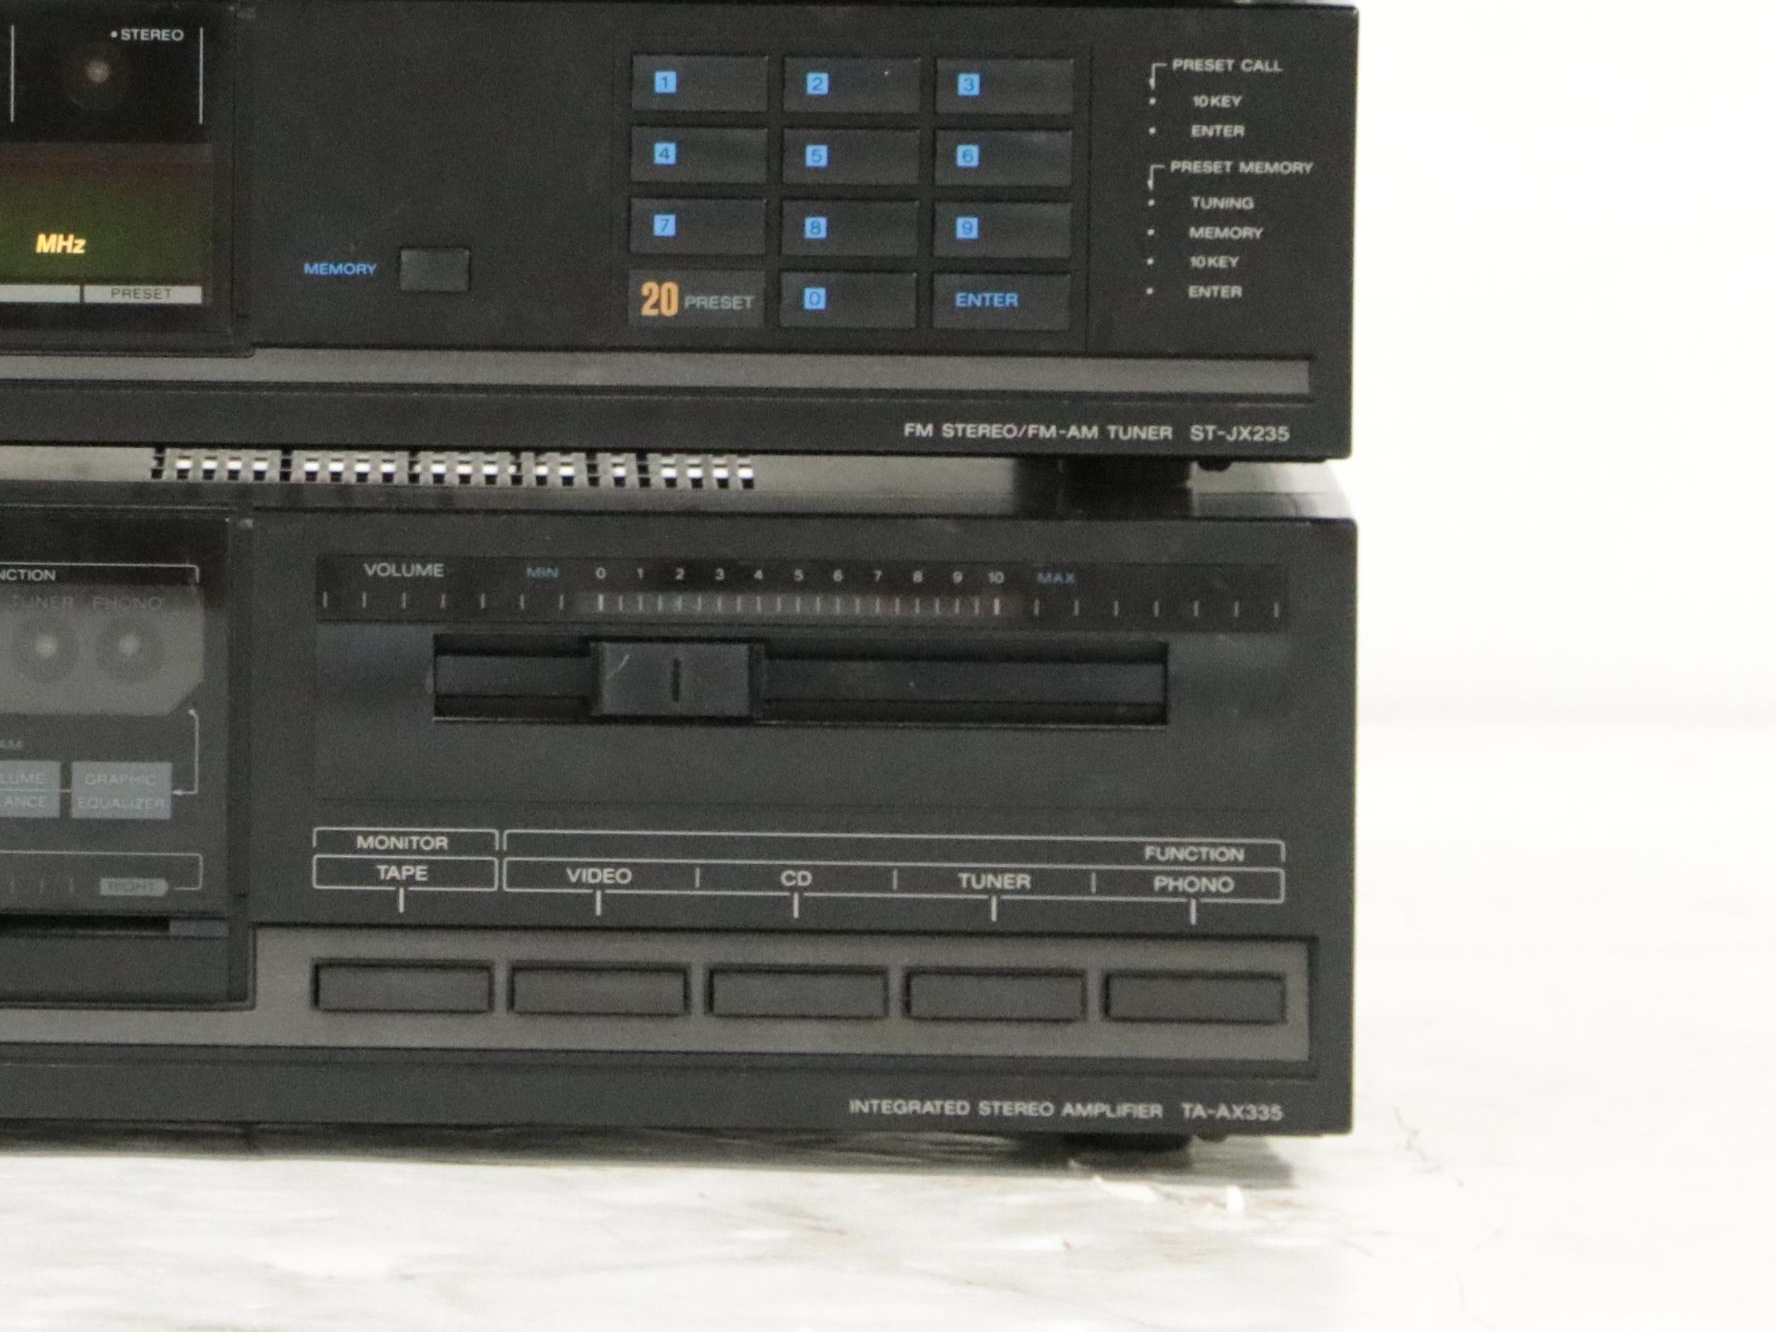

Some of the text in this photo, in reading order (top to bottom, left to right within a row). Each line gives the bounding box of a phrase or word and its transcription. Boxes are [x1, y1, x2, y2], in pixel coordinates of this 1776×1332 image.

[121, 28, 184, 41] STEREO
[1172, 59, 1283, 72] PRESET CALL
[1191, 125, 1244, 137] ENTER
[1171, 161, 1313, 174] PRESET MEMORY
[1191, 197, 1254, 209] TUNING
[1189, 226, 1262, 239] MEMORY
[36, 234, 86, 254] MHz
[304, 262, 377, 276] MEMORY
[111, 287, 171, 299] PRESET
[641, 281, 754, 316] 20 PRESET
[1189, 285, 1243, 298] ENTER
[955, 293, 1018, 307] ENTER
[904, 424, 933, 437] FM
[1108, 425, 1173, 439] TUNER
[1190, 425, 1289, 441] ST-JX235
[364, 563, 444, 578] VOLUME
[84, 773, 156, 786] GRAPHIC
[77, 797, 164, 810] EQUALIZER
[357, 836, 448, 850] MONITOR
[1145, 847, 1245, 862] FUNCTION
[377, 866, 428, 882] TAPE
[566, 868, 632, 884] VIDEO
[781, 871, 812, 887] CD
[958, 873, 1031, 889] TUNER
[1154, 876, 1234, 893] PHONO
[849, 1099, 970, 1115] INTEGRATED
[978, 1101, 1055, 1117] STEREO
[1061, 1102, 1162, 1118] AMPLIFIER
